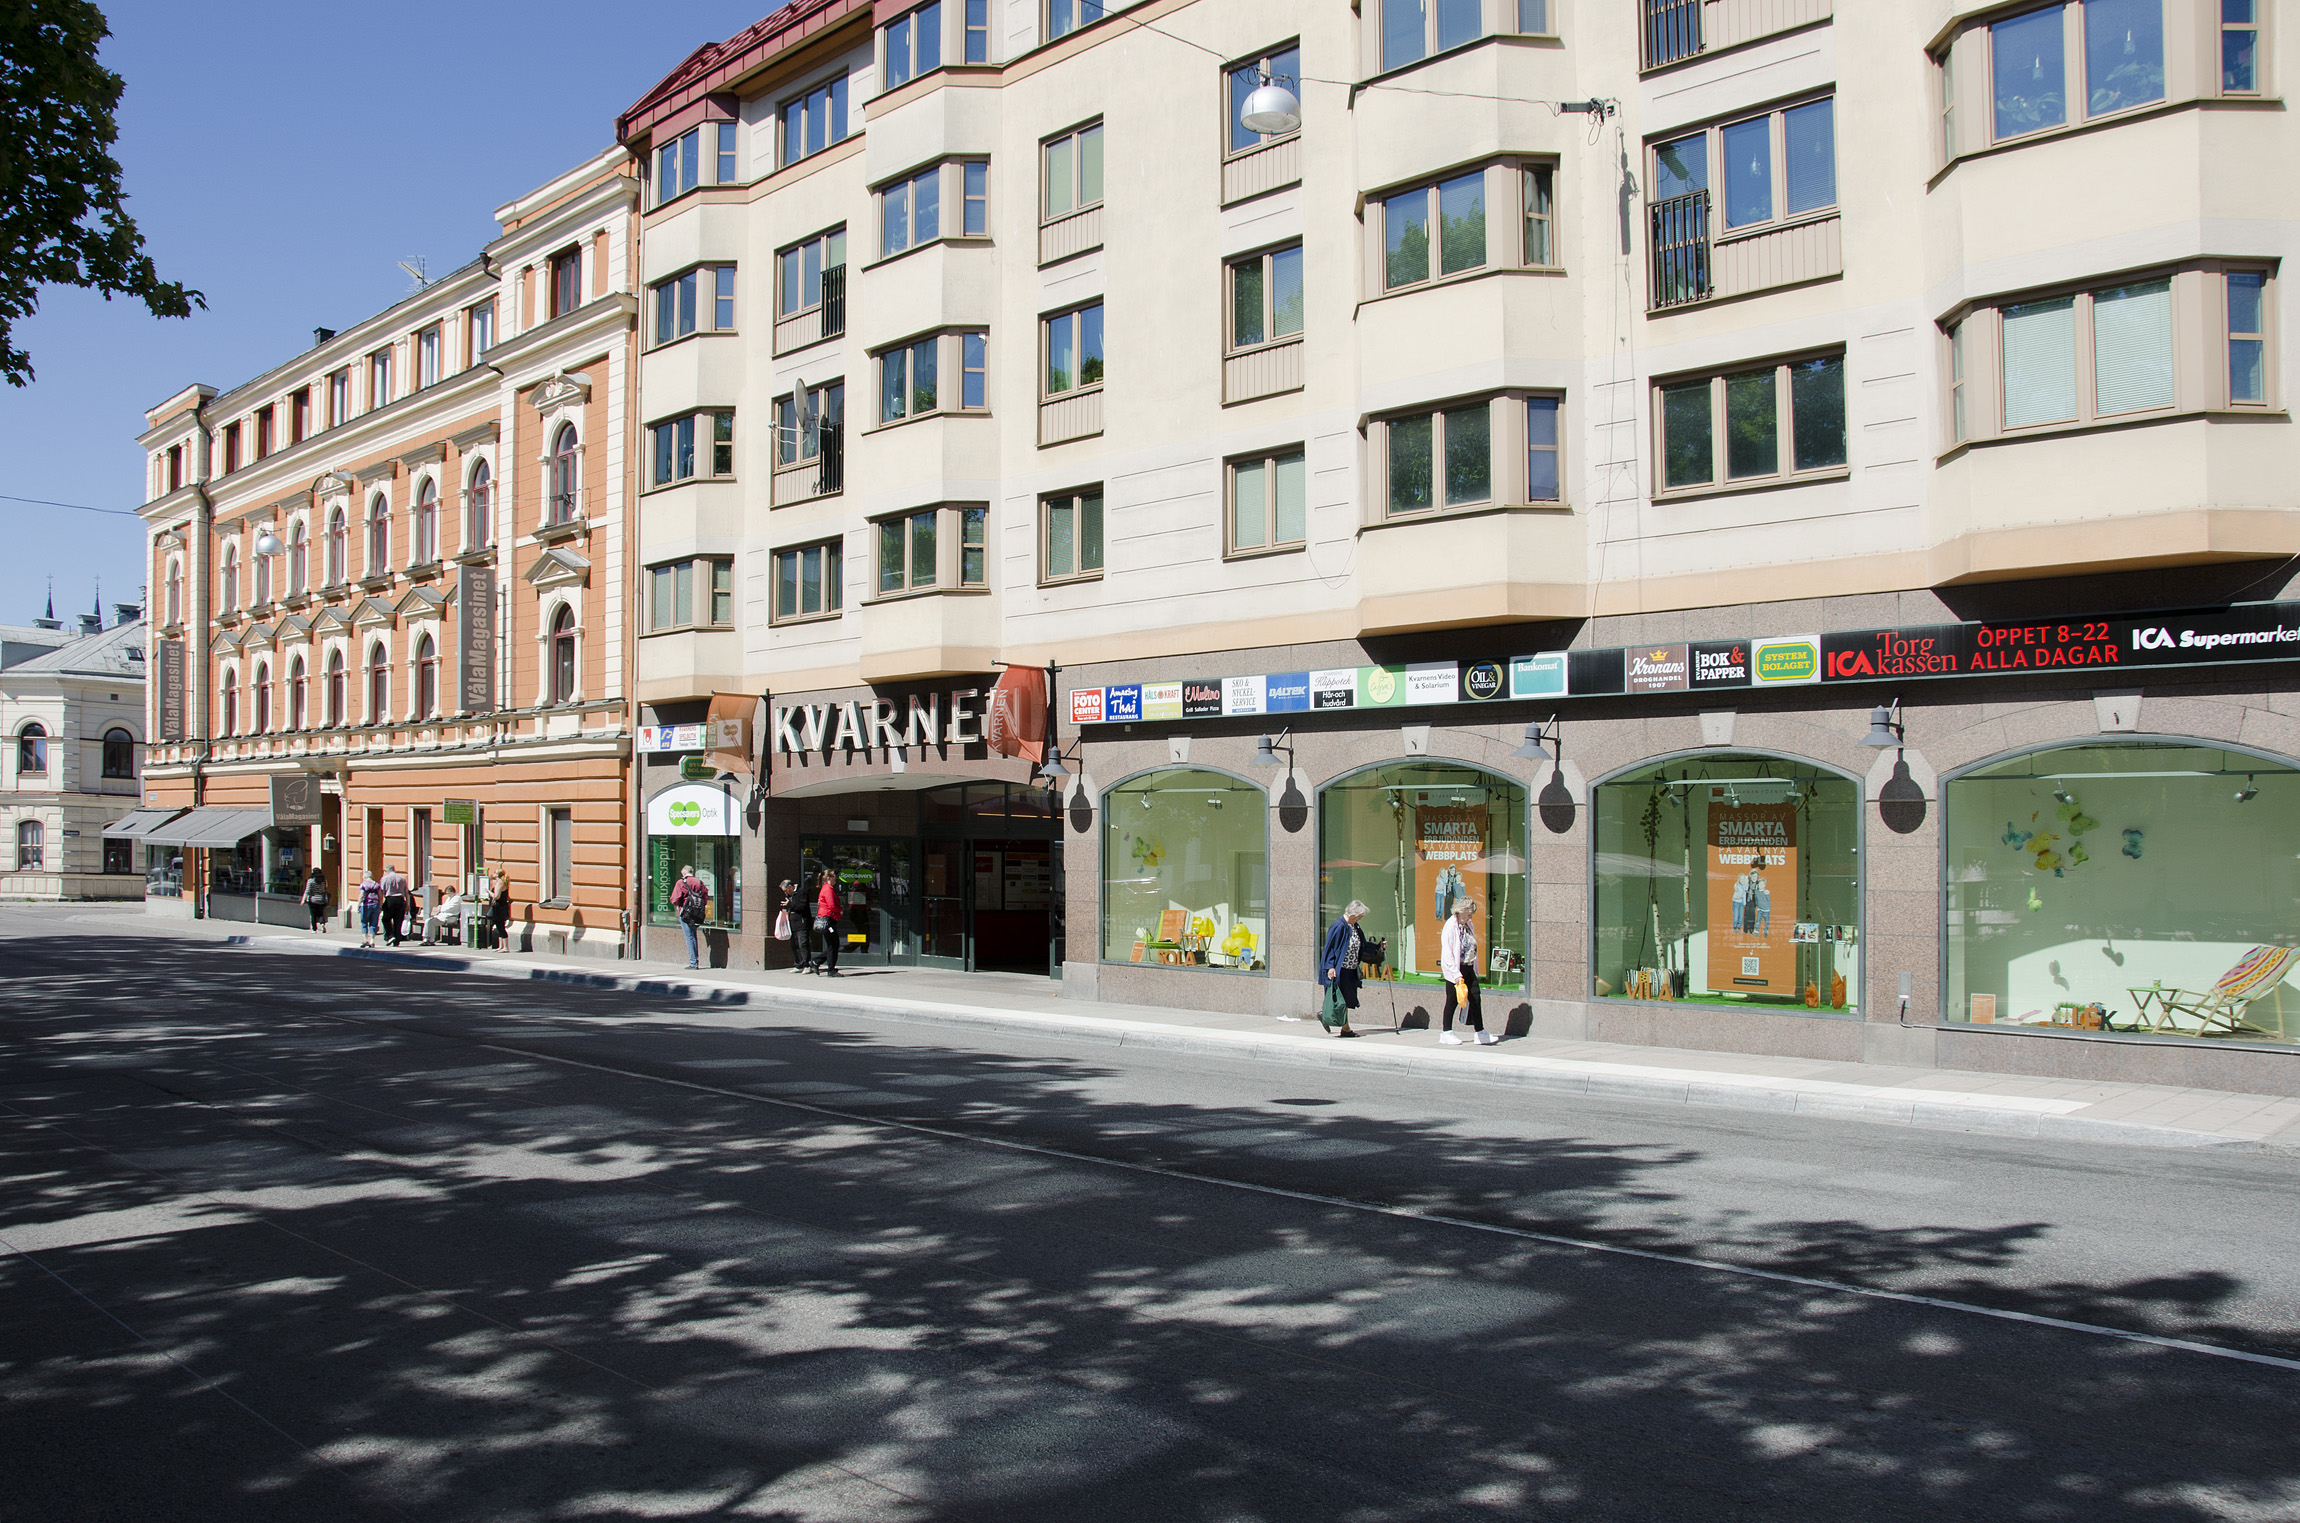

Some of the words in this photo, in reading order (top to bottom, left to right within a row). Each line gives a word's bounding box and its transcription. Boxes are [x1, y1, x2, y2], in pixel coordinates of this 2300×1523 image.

[467, 572, 490, 705] VålaMagasinet
[1977, 625, 2050, 648] ÖPPET
[2132, 627, 2176, 650] ICA
[1877, 632, 1935, 658] Torg
[1700, 652, 1731, 667] BOK
[1731, 646, 1745, 664] &
[1764, 651, 1808, 662] SYSTEM
[1877, 649, 1958, 675] kassen
[1970, 650, 2028, 670] ALLA
[2035, 644, 2119, 667] DAGAR
[1518, 661, 1559, 672] Bankomat
[1629, 657, 1686, 677] Kronans
[1762, 661, 1811, 672] BOLAGET
[1828, 650, 1875, 677] ICA
[1438, 673, 1456, 681] Video
[1632, 676, 1683, 684] DROGHANDEL
[1700, 667, 1746, 681] PAPPER
[164, 644, 182, 736] VålaMagasinet
[1232, 679, 1244, 688] SKO
[1421, 680, 1450, 689] Solarium
[1648, 681, 1666, 689] 1907
[1110, 687, 1138, 700] Amazing
[1269, 686, 1308, 699] DALTEK
[1074, 694, 1101, 708] FOTO
[1110, 697, 1137, 714] Thai
[1232, 697, 1256, 707] SERVICE
[1323, 699, 1346, 708] hudvård
[1074, 706, 1101, 715] CENTER
[776, 687, 1021, 753] KVARNEN
[991, 689, 1009, 753] KVARNEN
[670, 808, 701, 819] Specsavers
[702, 807, 718, 819] Optik
[1424, 814, 1462, 822] MASSOR
[1466, 814, 1478, 822] AV
[1720, 812, 1766, 821] MASSOR
[1772, 812, 1786, 821] AV
[1424, 821, 1478, 835] SMARTA
[1719, 821, 1786, 835] SMARTA
[1424, 835, 1480, 844] ERBJUDANDEN
[1719, 836, 1788, 846] ERBJUDANDEN
[1424, 842, 1435, 851] PÅ
[1439, 842, 1456, 851] VÅR
[1460, 843, 1478, 851] NYA
[1764, 846, 1787, 854] NYA
[1425, 850, 1478, 861] WEBBPLATS
[1719, 853, 1786, 866] WEBBPLATS
[840, 871, 873, 880] Specsavers
[1624, 981, 1675, 1002] VILA
